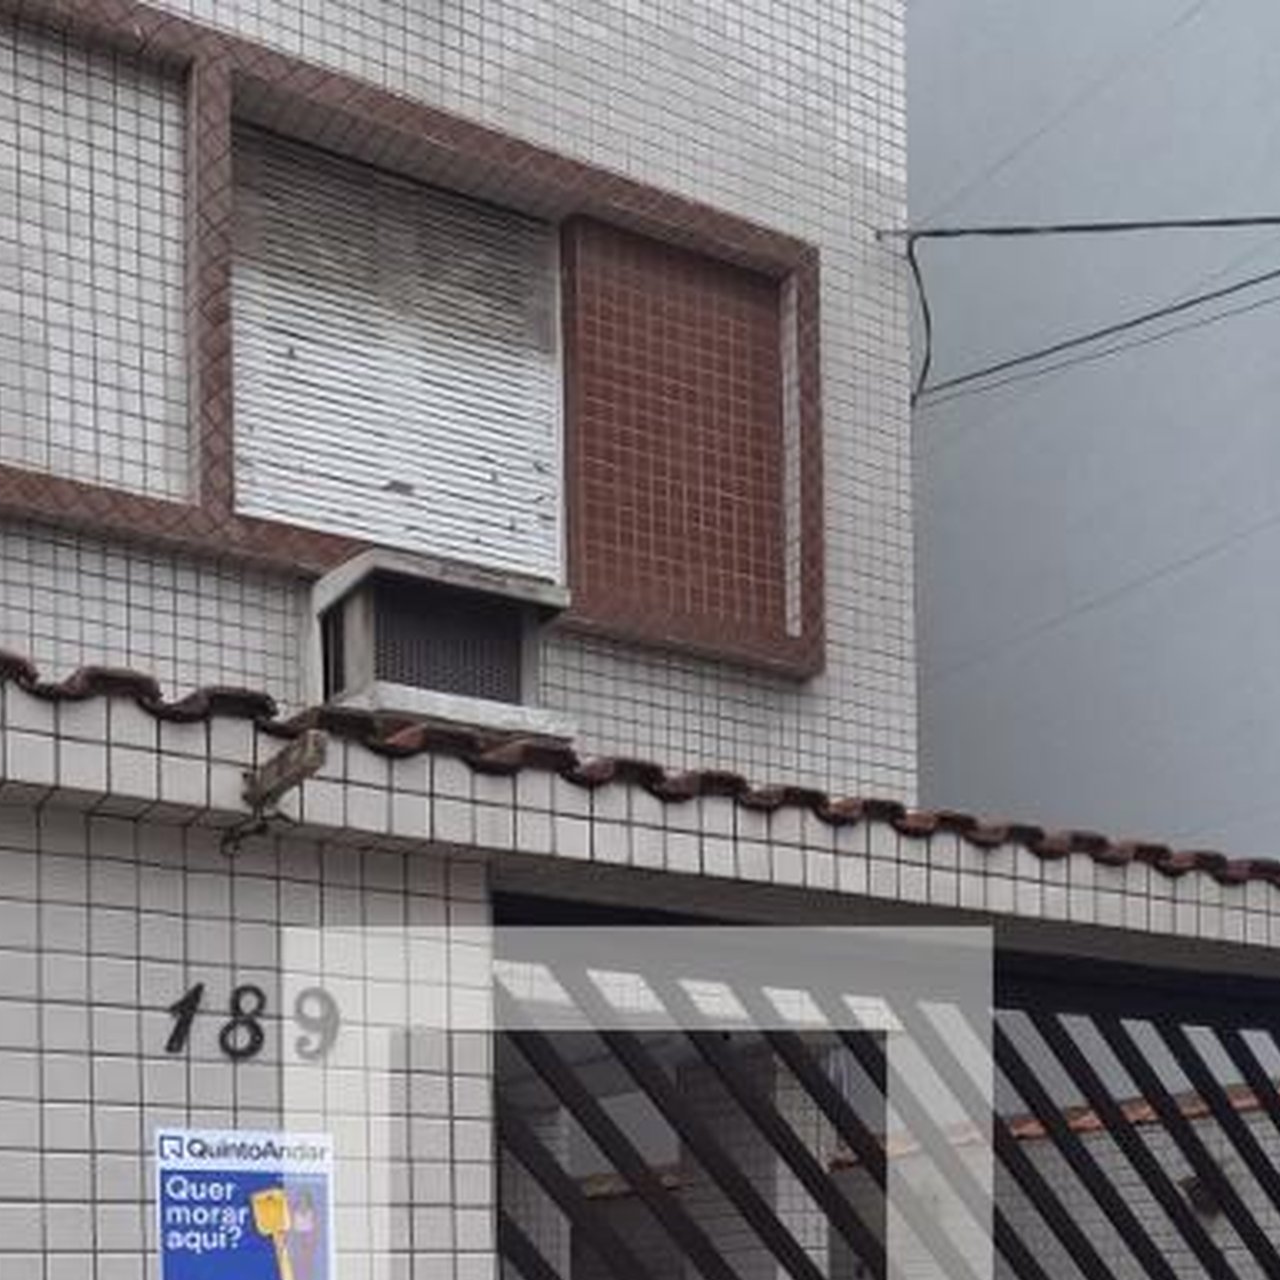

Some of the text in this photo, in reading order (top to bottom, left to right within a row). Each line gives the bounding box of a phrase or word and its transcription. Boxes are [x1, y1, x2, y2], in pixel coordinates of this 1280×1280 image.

[165, 982, 340, 1060] 189
[187, 1138, 325, 1161] QuintoAndar
[166, 1175, 236, 1201] Quer
[166, 1205, 249, 1225] morar
[166, 1226, 242, 1254] aqui?
